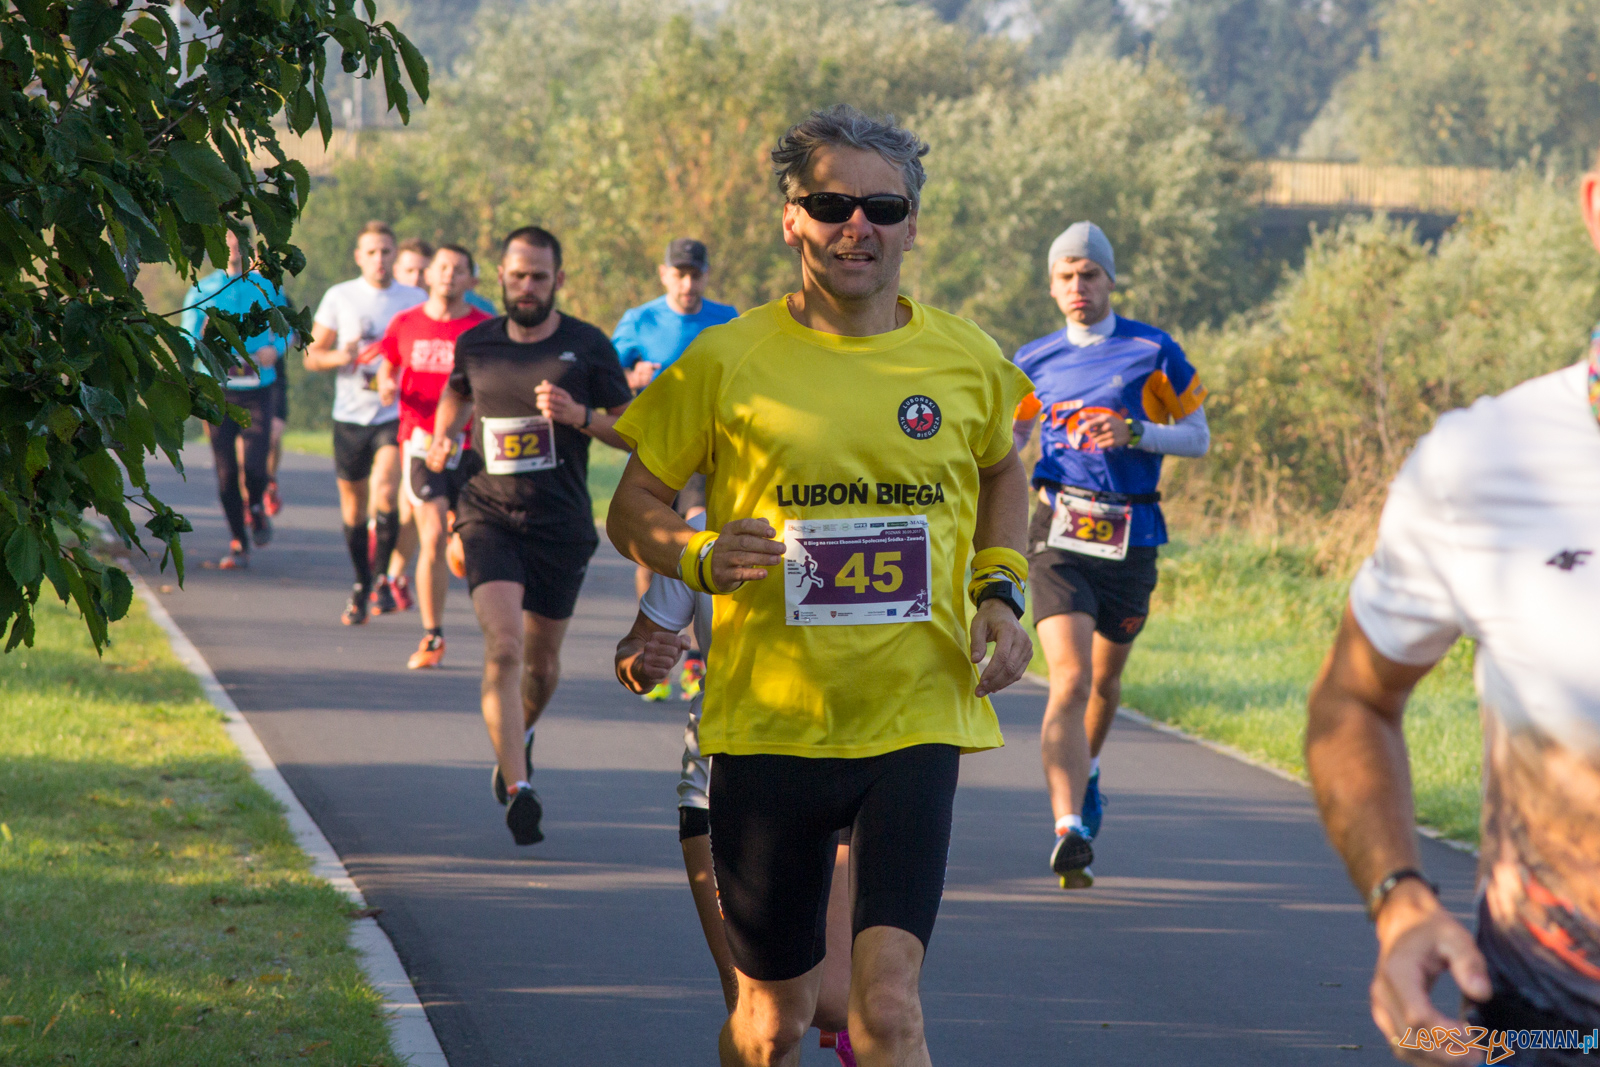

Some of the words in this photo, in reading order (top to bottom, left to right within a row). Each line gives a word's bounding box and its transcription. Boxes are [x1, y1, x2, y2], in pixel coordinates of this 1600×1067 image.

[902, 396, 936, 409] LUBOŃSKI
[900, 416, 911, 433] KLUB
[916, 416, 940, 438] BIEGACZA
[503, 433, 540, 458] 52
[776, 477, 869, 507] LUBOŃ
[876, 482, 945, 506] BIEGA
[1075, 516, 1114, 542] 29
[834, 551, 904, 594] 45
